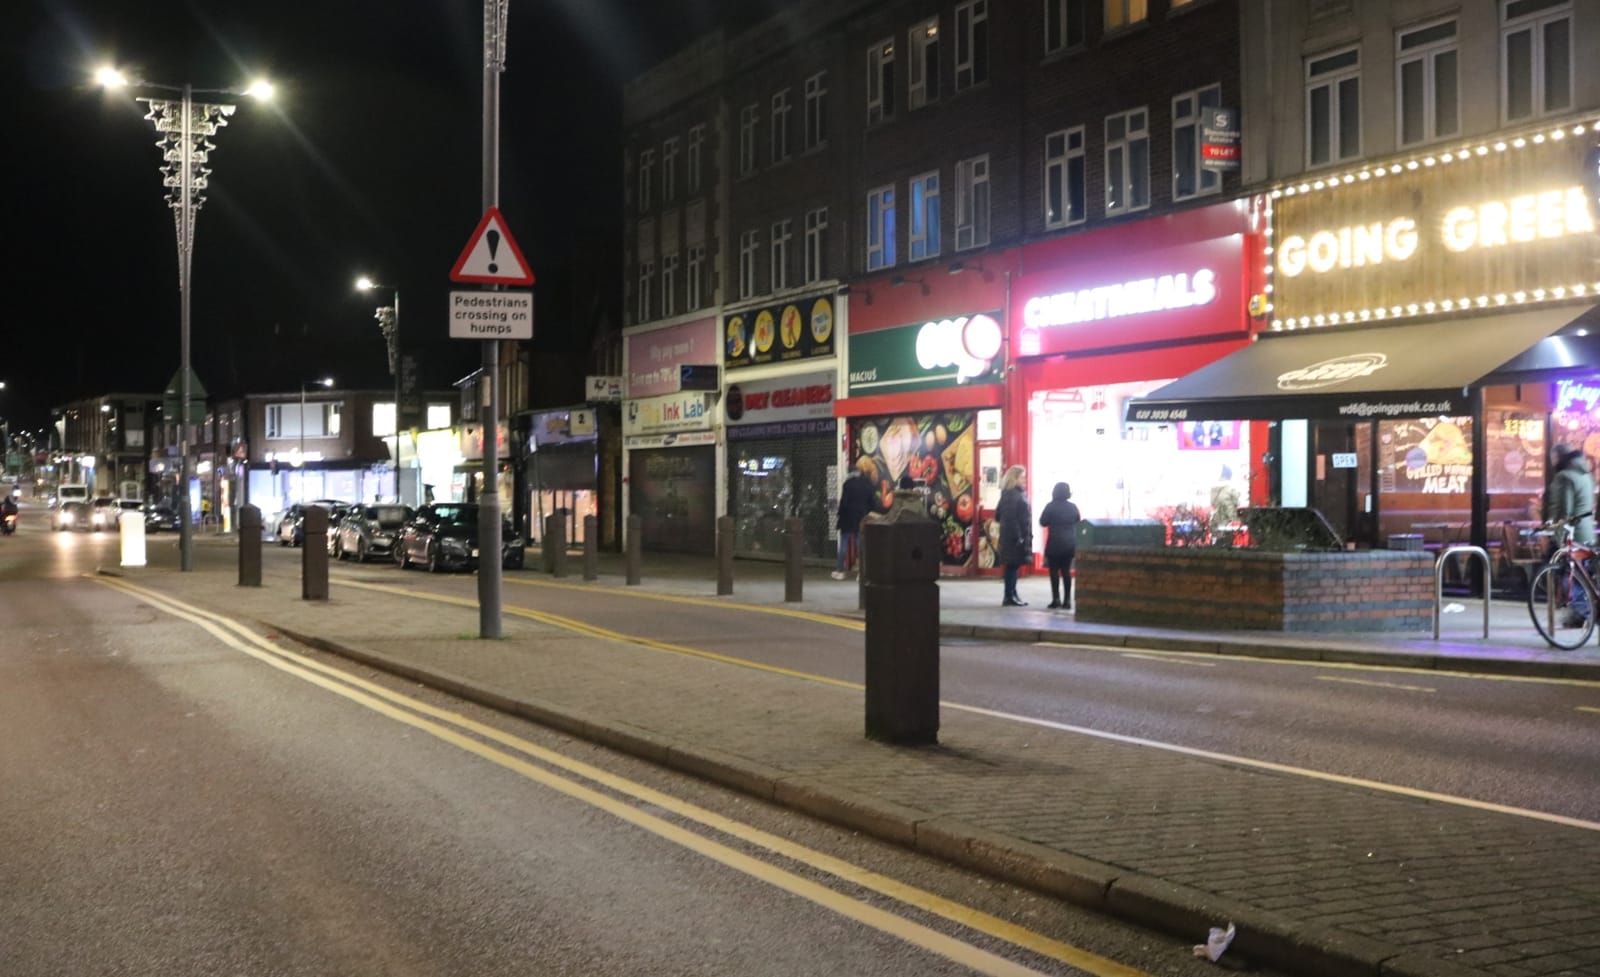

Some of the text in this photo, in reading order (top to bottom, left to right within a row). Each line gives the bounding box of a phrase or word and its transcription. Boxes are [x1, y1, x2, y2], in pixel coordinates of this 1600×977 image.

[1278, 186, 1594, 278] GOING GREEK
[455, 296, 528, 308] Pedestrians
[455, 310, 527, 323] crossing on
[470, 324, 512, 335] humps
[771, 383, 832, 408] CLEANERS
[663, 402, 680, 421] Ink
[683, 399, 703, 419] Lab
[1338, 399, 1452, 417] wd6@goinggreek.co.uk
[1334, 455, 1355, 466] OPEN
[1422, 475, 1469, 494] MEAT
